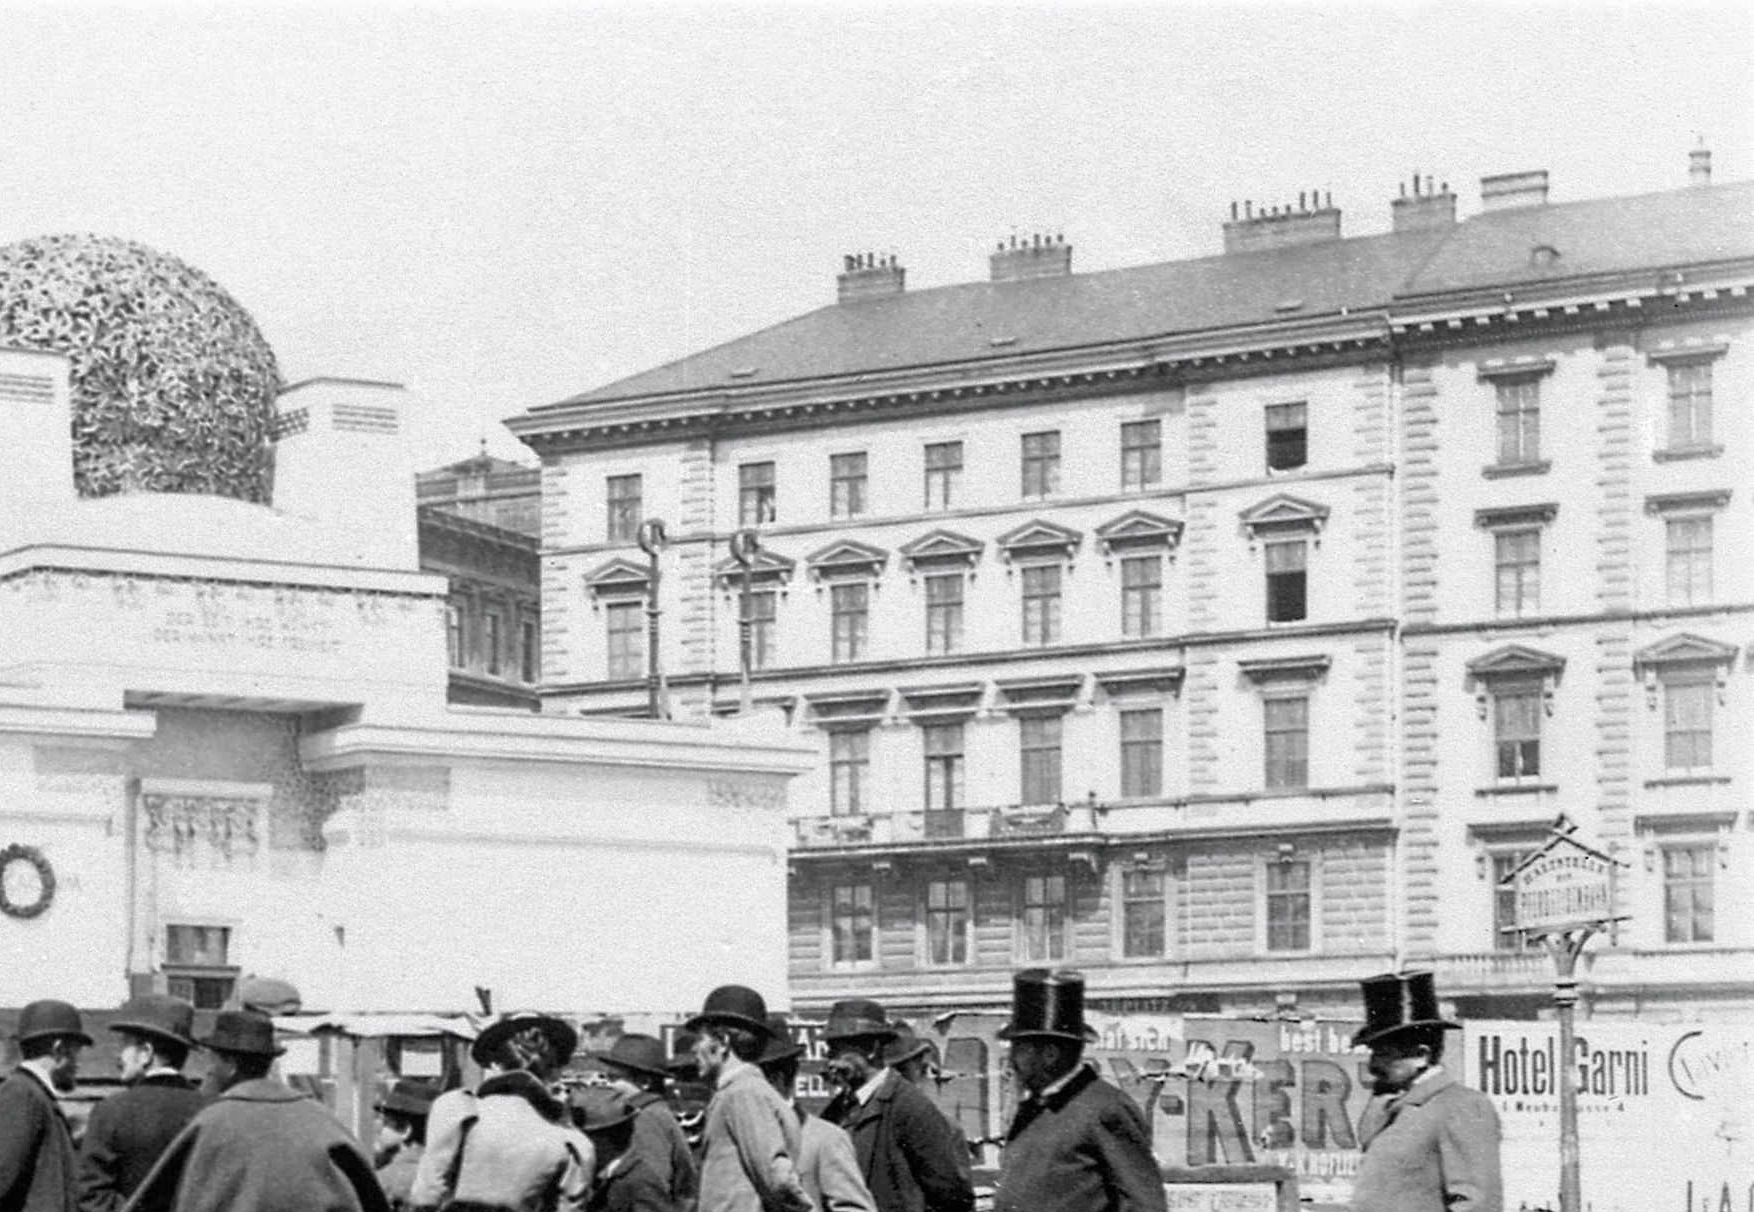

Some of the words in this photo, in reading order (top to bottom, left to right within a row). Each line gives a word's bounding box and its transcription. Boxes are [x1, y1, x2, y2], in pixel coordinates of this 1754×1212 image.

[1280, 1024, 1321, 1053] best
[1478, 1035, 1555, 1095] Hotel
[1572, 1036, 1648, 1095] Garni
